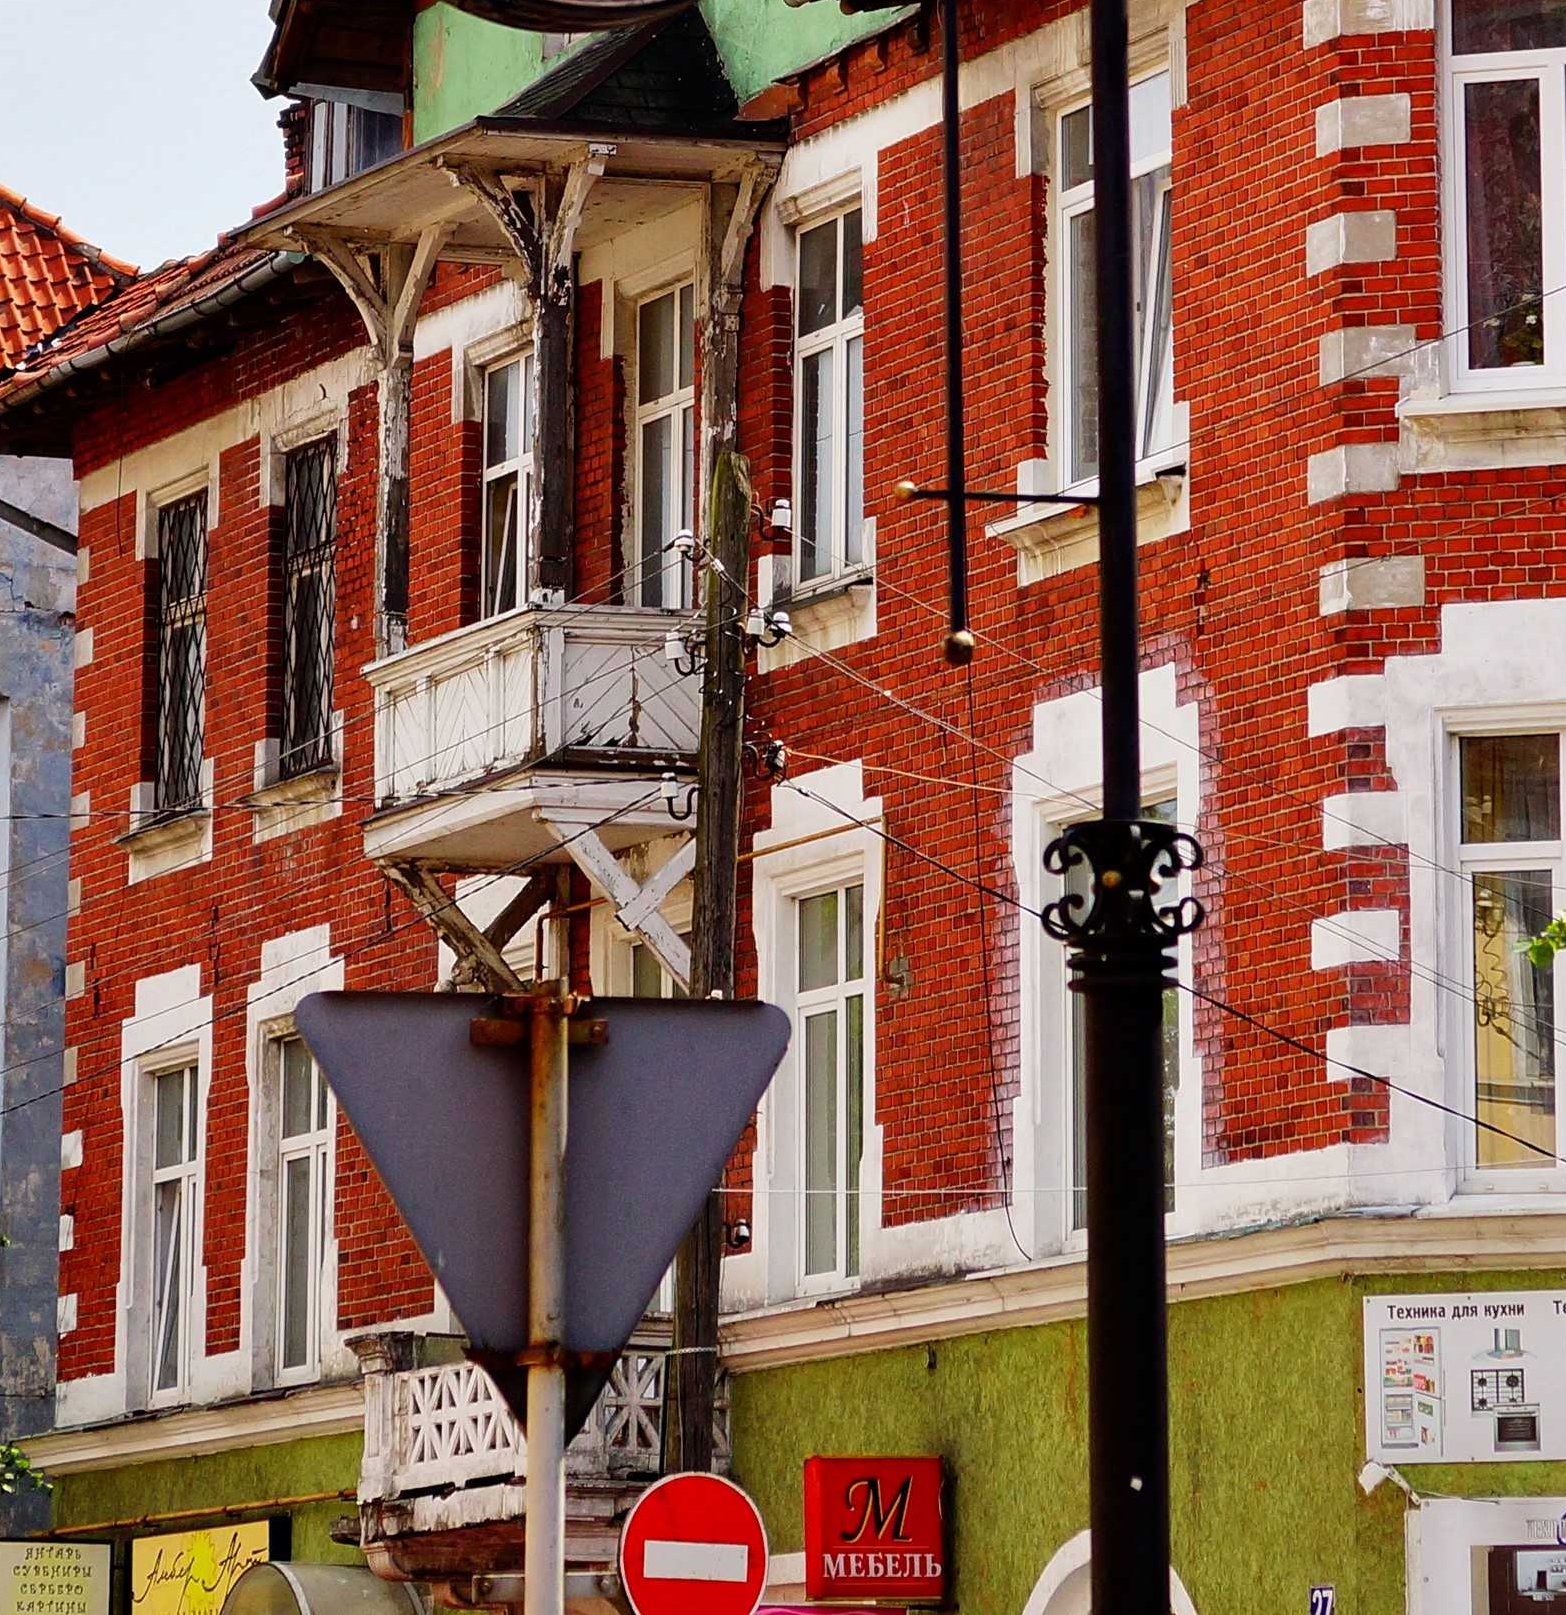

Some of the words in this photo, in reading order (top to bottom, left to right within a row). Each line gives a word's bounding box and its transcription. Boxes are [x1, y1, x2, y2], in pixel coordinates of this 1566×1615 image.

[1387, 1305, 1446, 1320] Техника
[1451, 1305, 1478, 1320] для
[1484, 1304, 1525, 1320] кухни
[24, 1545, 82, 1560] ЯНТАРЬ
[822, 1551, 942, 1578] МЕБЕЛЬ
[20, 1583, 84, 1596] СЕРЕБРО
[16, 1600, 87, 1614] КАРТИНЫ
[1313, 1590, 1333, 1615] 27
